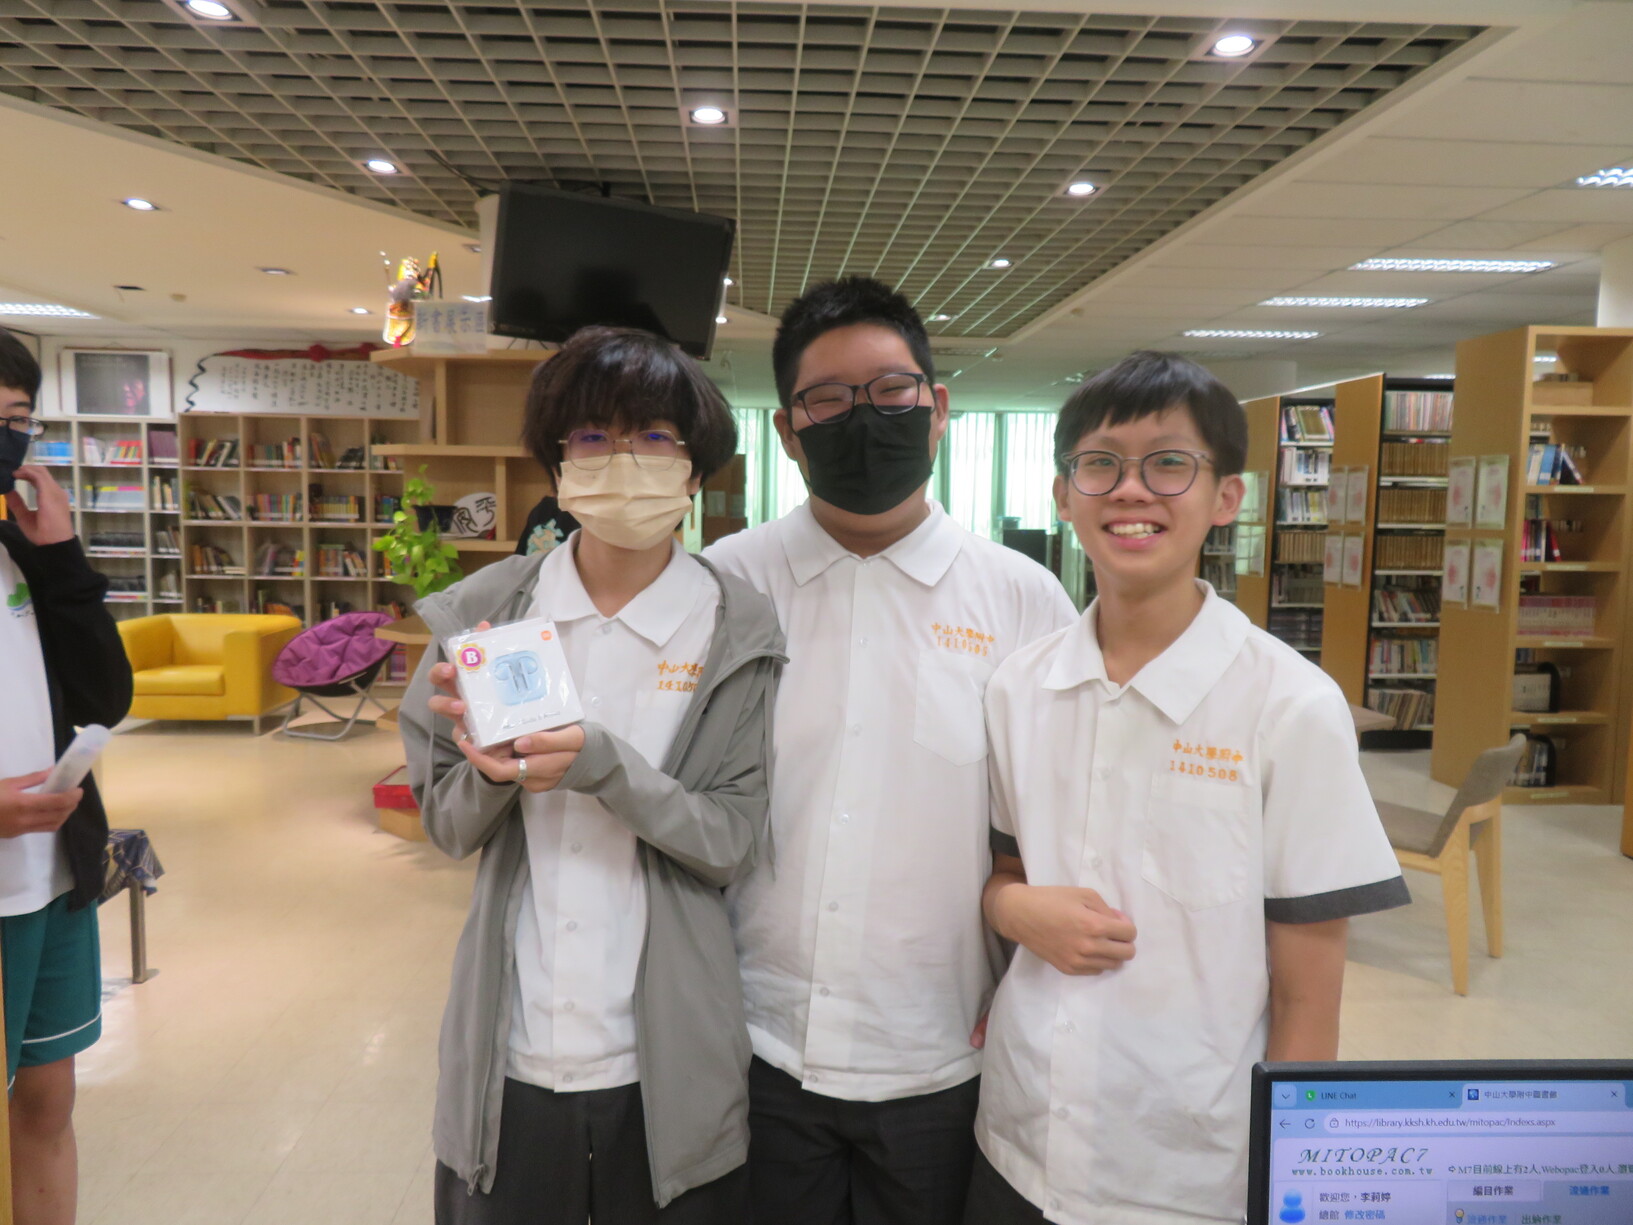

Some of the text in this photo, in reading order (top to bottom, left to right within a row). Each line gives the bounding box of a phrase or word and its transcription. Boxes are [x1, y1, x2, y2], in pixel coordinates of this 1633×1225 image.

[465, 651, 479, 665] B
[1172, 738, 1244, 765] 中山大學附中
[1169, 759, 1238, 782] 1410508
[1340, 1091, 1357, 1099] Chat
[1297, 1147, 1429, 1164] MITOPAC7
[1291, 1166, 1433, 1176] www.bookhouse.com.tw
